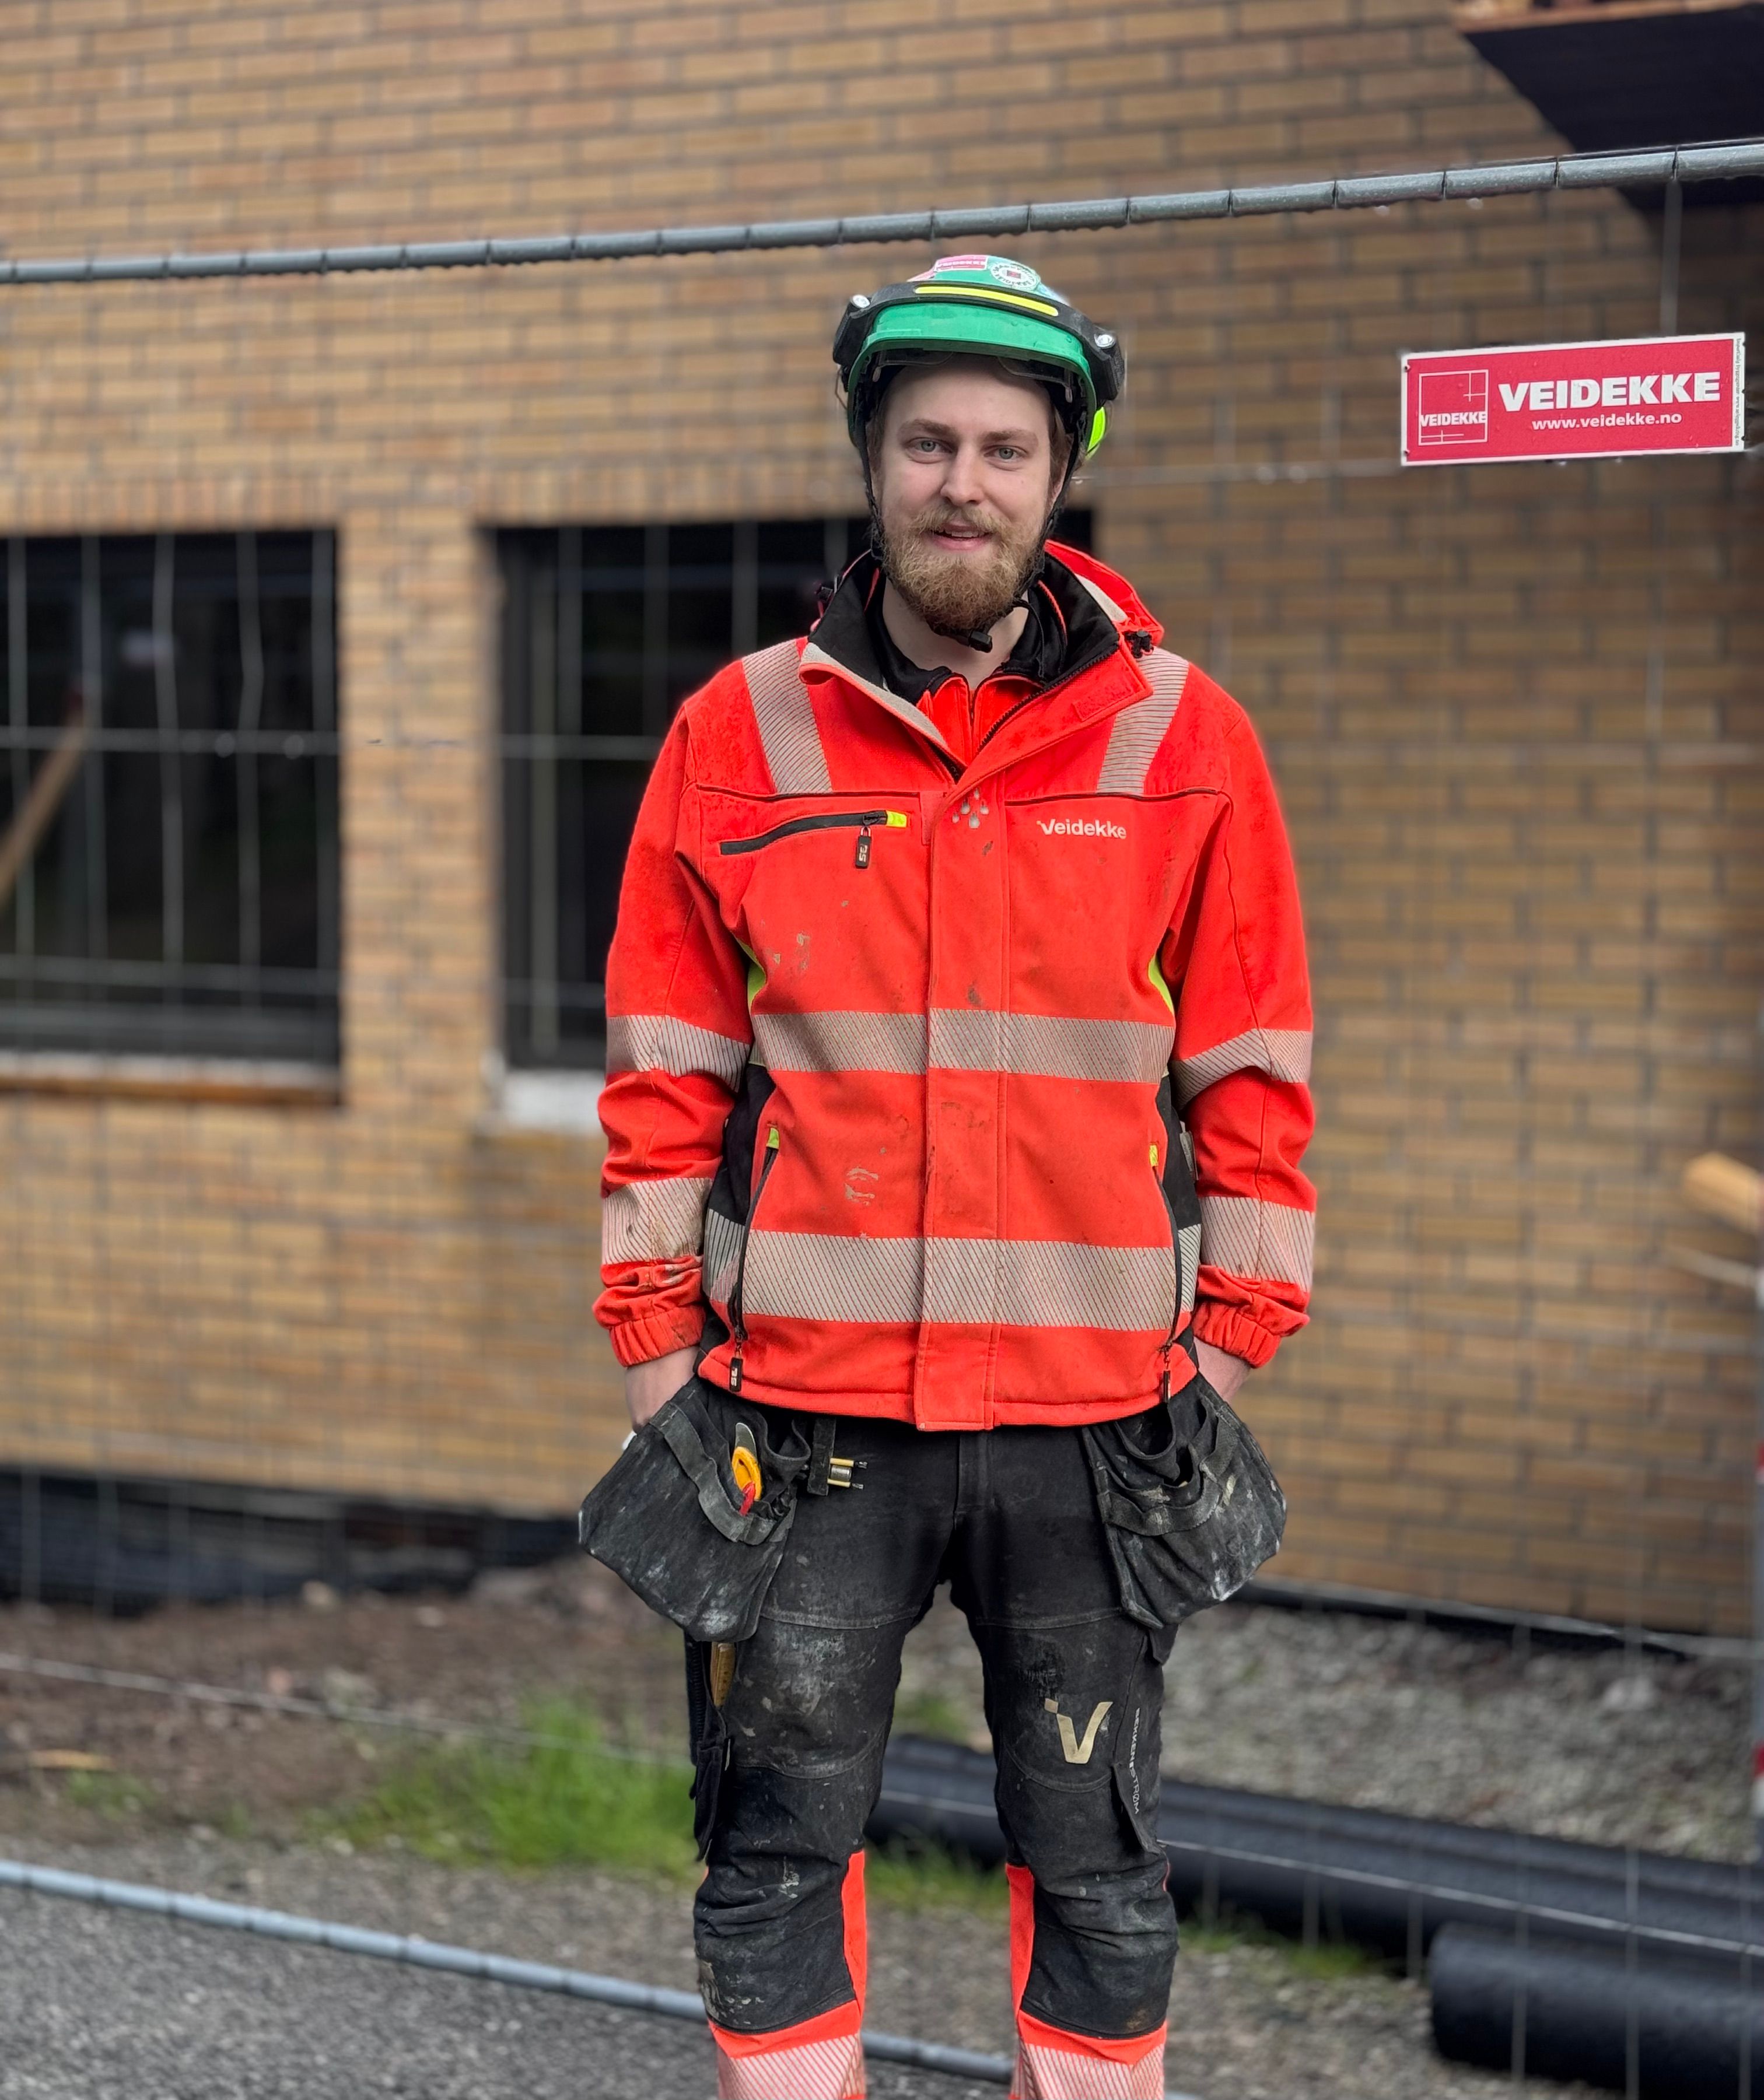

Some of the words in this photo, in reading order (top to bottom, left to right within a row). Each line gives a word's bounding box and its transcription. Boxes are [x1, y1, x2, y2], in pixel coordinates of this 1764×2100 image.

[1497, 371, 1720, 412] VEIDEKKE
[1420, 411, 1486, 427] VEIDEKKE
[1532, 412, 1682, 430] www.veidekke.no
[1036, 818, 1127, 840] Veidekke
